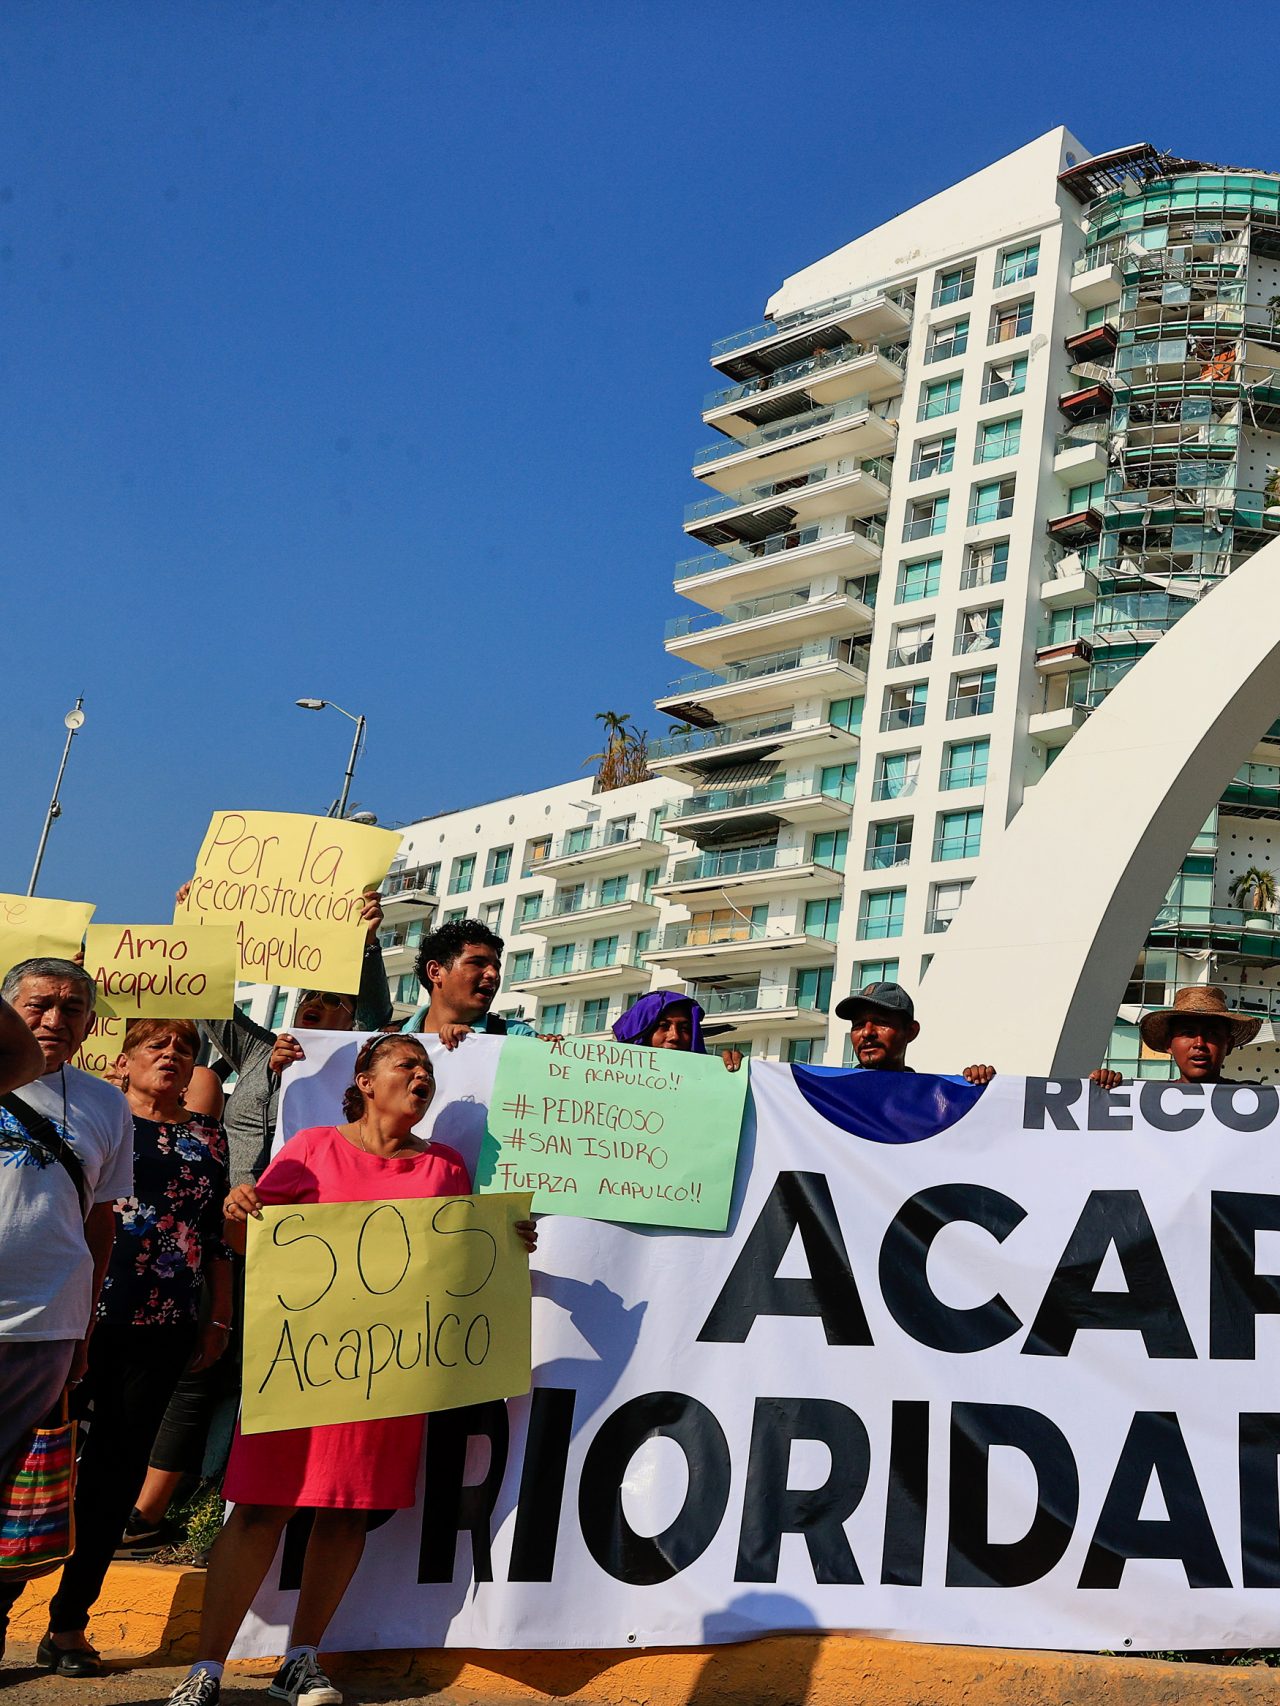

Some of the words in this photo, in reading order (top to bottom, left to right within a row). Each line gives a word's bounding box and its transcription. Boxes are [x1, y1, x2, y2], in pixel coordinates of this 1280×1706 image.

[204, 814, 279, 878] Por
[299, 822, 343, 887] la
[187, 876, 366, 927] reconstrucción
[114, 929, 187, 960] Amo
[237, 921, 321, 981] Acapulco
[95, 964, 206, 1008] Acapulco
[550, 1040, 660, 1071] ACUERDATE
[549, 1063, 570, 1080] DE
[585, 1067, 684, 1091] ACAPULCO!!
[503, 1128, 572, 1156] #SAN
[577, 1137, 668, 1169] ISIDRO
[498, 1163, 577, 1193] FUERZA
[599, 1177, 702, 1203] ACAPULCO!!
